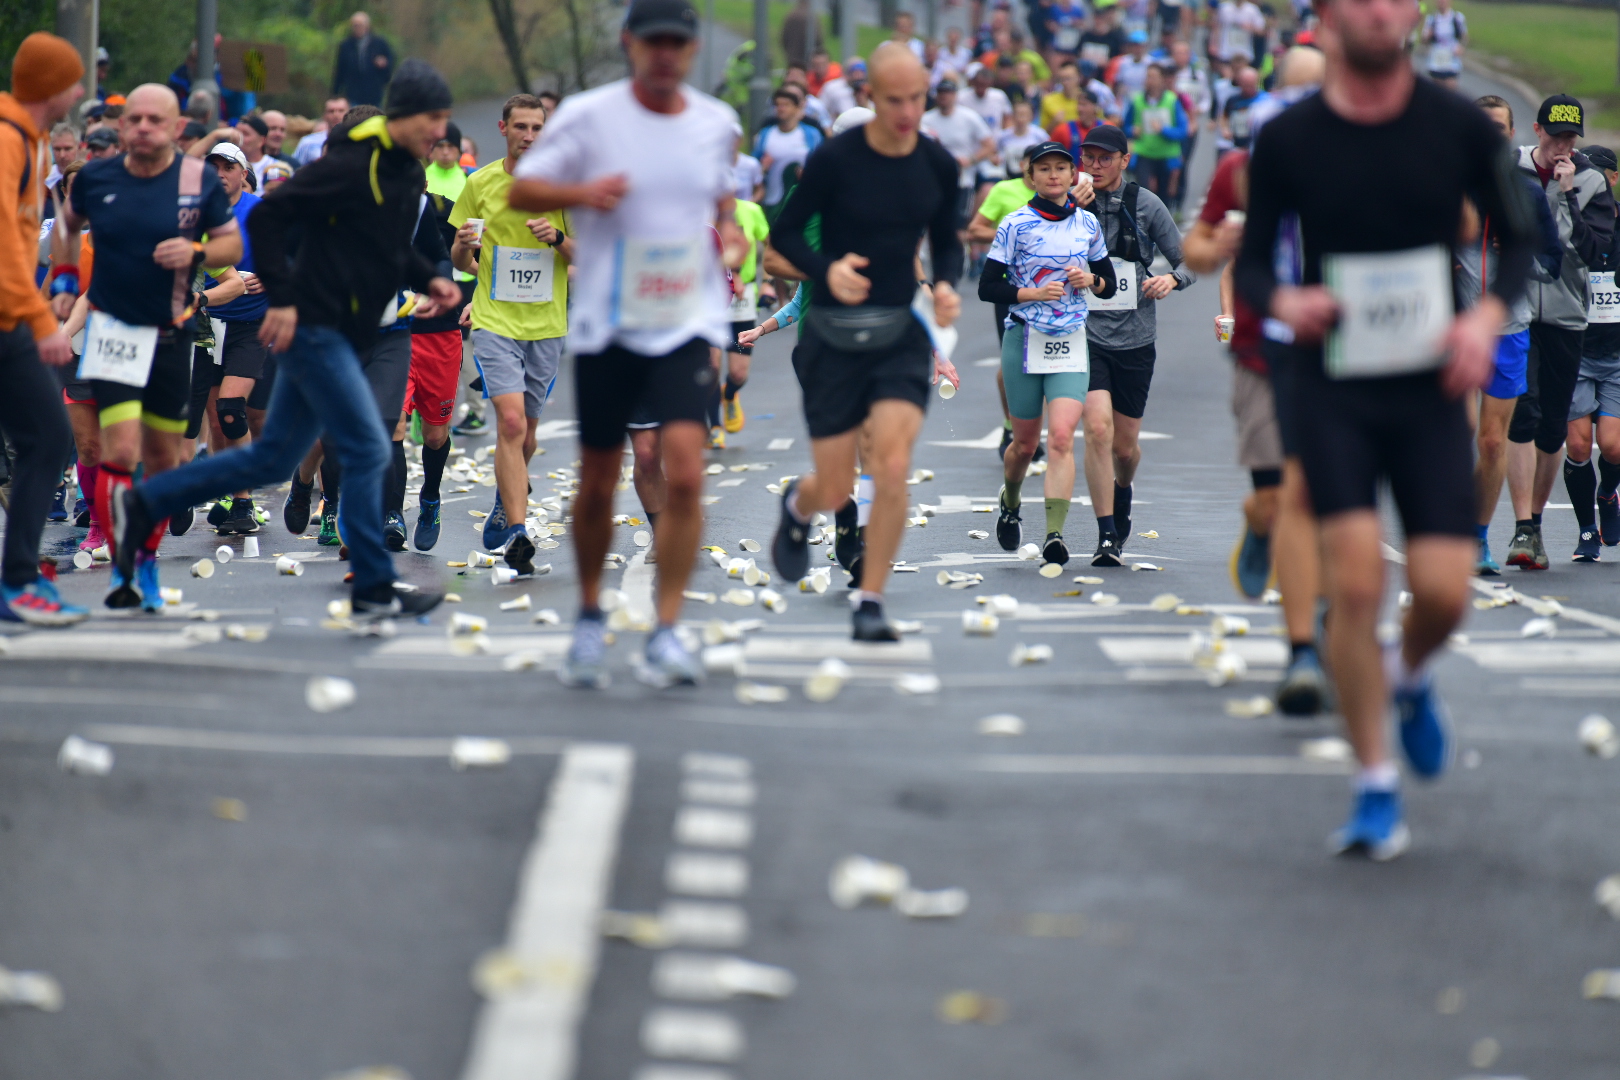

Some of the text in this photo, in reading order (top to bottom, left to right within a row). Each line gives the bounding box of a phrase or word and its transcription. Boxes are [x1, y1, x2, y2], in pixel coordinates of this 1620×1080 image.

[1551, 104, 1579, 115] GOOD
[1548, 113, 1580, 124] GRACE
[510, 251, 522, 260] 22
[510, 269, 541, 283] 1197
[1590, 275, 1602, 284] 22
[1591, 291, 1620, 305] 1323
[97, 338, 138, 361] 1523
[1044, 341, 1070, 355] 595
